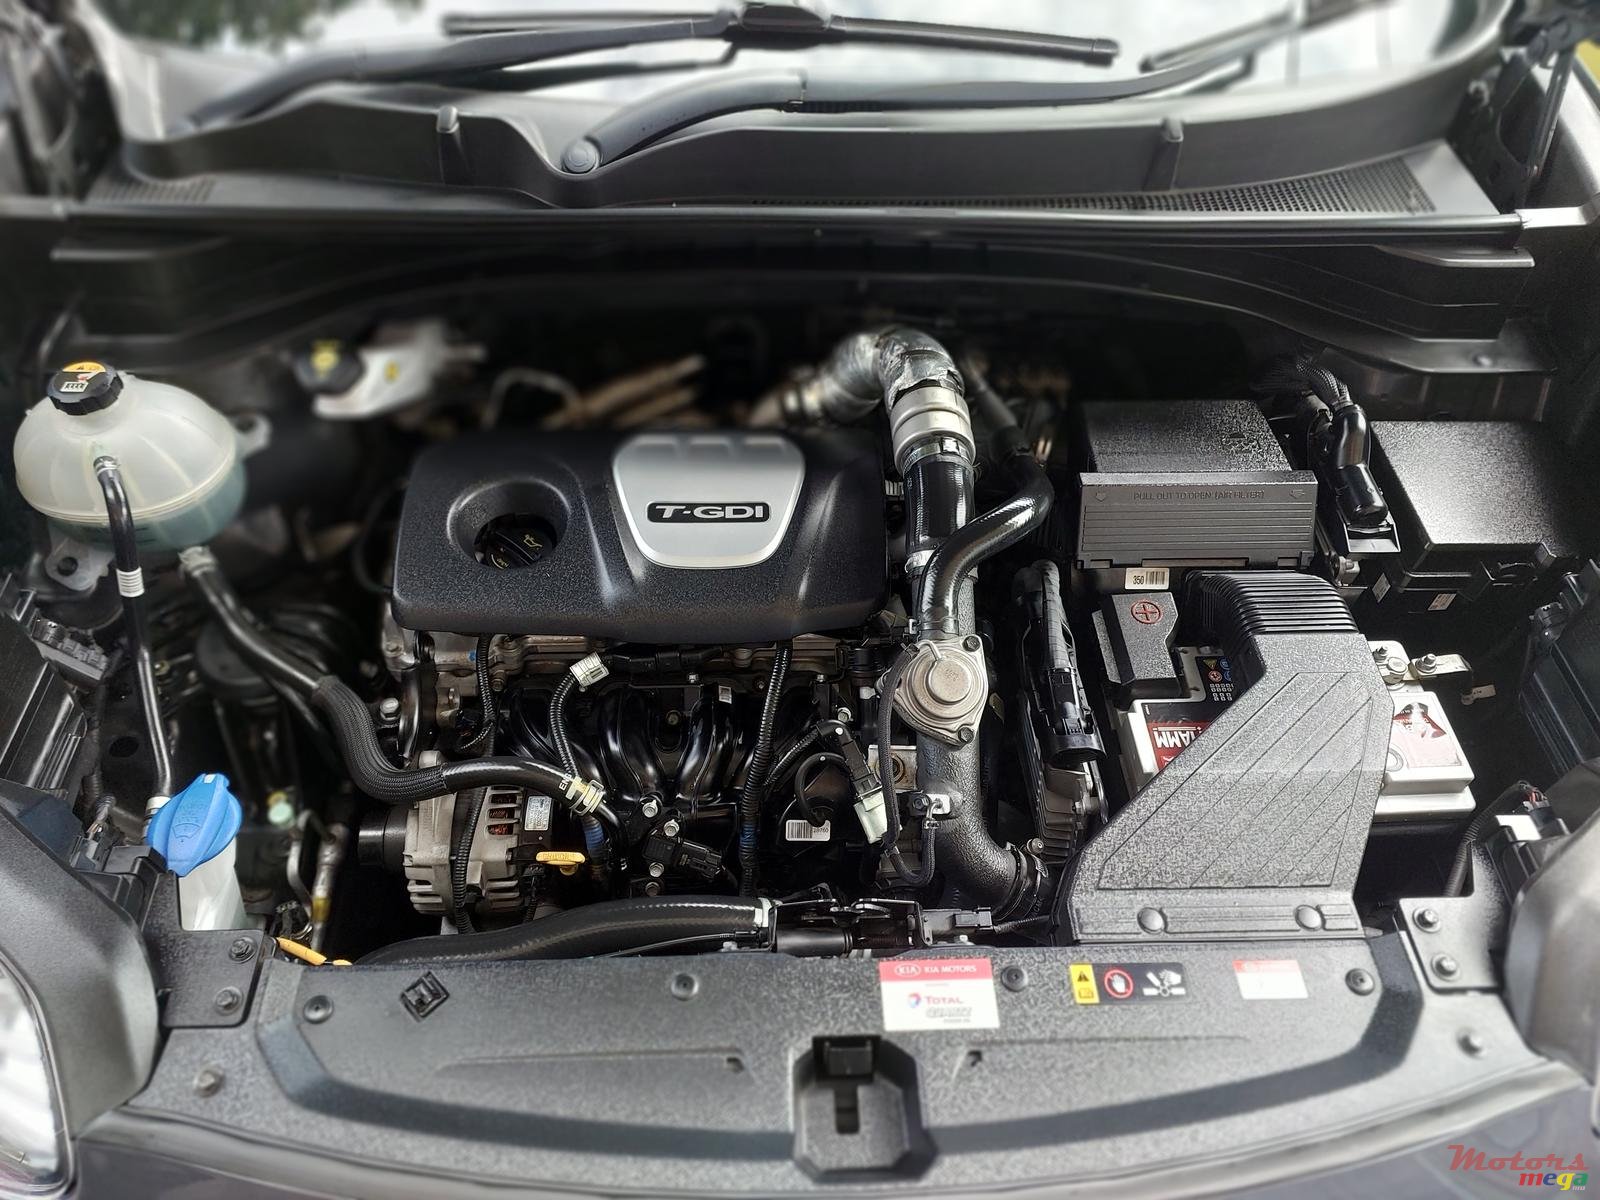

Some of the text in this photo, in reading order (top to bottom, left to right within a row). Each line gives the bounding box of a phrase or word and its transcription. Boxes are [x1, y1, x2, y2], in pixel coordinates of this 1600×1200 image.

[1134, 491, 1154, 500] PULL
[1157, 491, 1173, 500] OUT
[1176, 491, 1187, 500] TO
[1189, 491, 1212, 500] OPEN
[656, 505, 764, 519] T-GDI
[1132, 575, 1144, 585] 350
[895, 964, 920, 976] KIA
[942, 965, 977, 973] MOTORS
